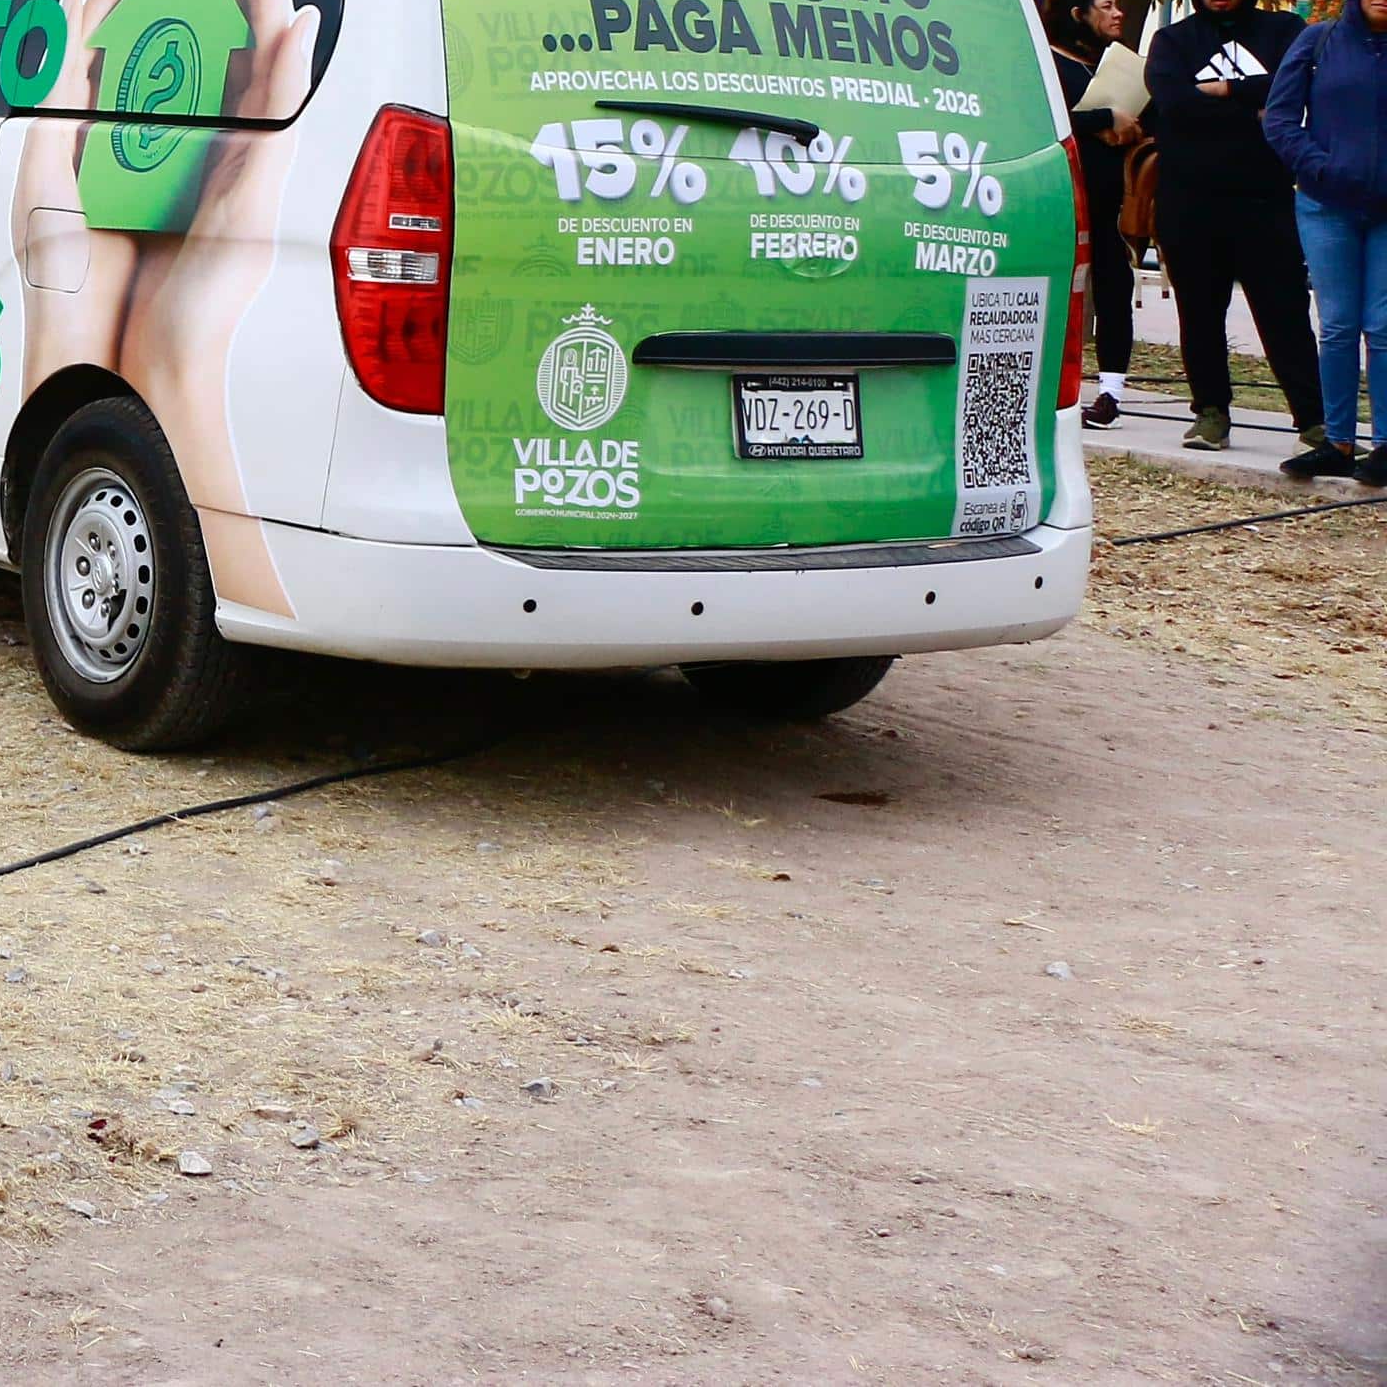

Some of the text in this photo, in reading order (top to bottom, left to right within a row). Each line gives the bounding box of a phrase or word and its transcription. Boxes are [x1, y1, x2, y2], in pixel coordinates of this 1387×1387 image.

[769, 1, 960, 76] MENOS
[530, 70, 658, 92] APROVECHA
[661, 71, 699, 92] LOS
[703, 72, 826, 98] DESCUENTOS
[829, 76, 920, 108] PREDIAL
[933, 88, 980, 116] 2026
[529, 118, 707, 205] 15%
[728, 126, 867, 203] 10%
[896, 130, 1003, 217] 5%
[558, 217, 692, 233] DE DESCUENTO EN
[750, 213, 860, 231] DE DESCUENTO EN
[904, 221, 1007, 248] DE DESCUENTO EN
[577, 236, 675, 265] ENERO
[750, 232, 859, 261] FEBRERO
[915, 242, 996, 277] MARZO
[971, 291, 1039, 307] UBICA TU CAJA
[969, 310, 1038, 325] RECAUDADORA
[992, 327, 1035, 343] CERCANA
[512, 438, 598, 467] VILLA
[601, 439, 639, 468] DE
[767, 446, 807, 456] HYUNDAI
[963, 502, 997, 515] Escanea
[992, 516, 1005, 532] QR
